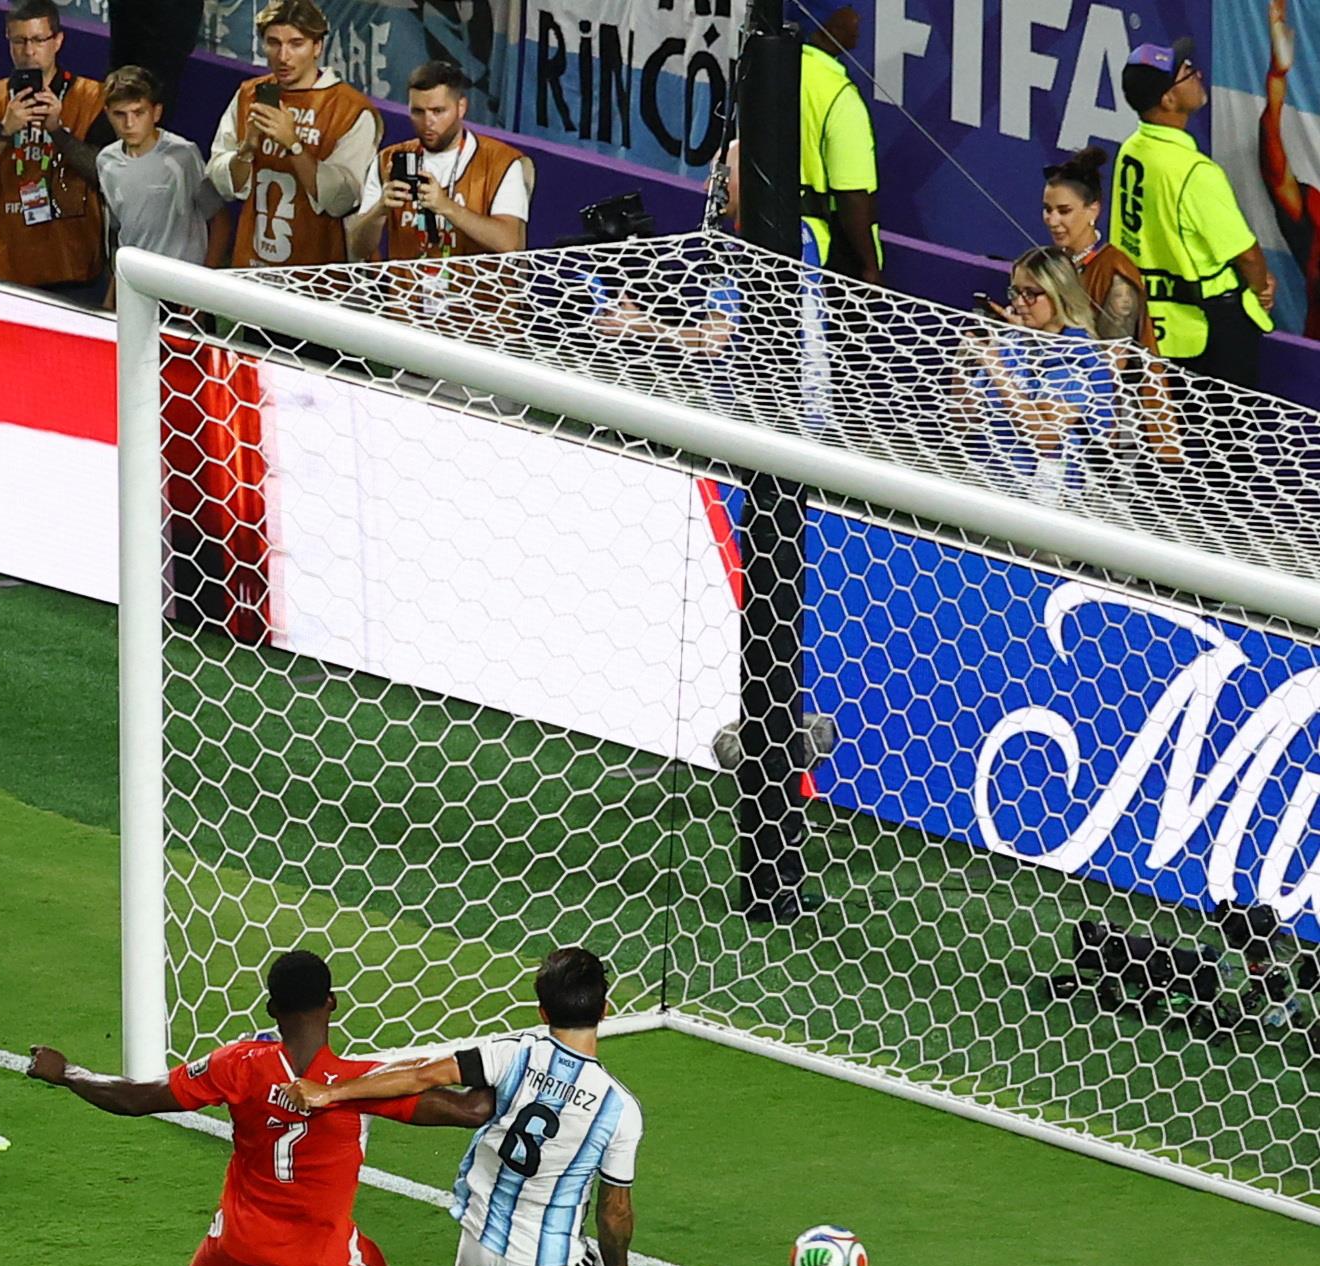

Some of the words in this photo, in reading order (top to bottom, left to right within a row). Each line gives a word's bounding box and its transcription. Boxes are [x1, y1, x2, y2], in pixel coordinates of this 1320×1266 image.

[873, 0, 1143, 153] FIFA
[526, 1066, 598, 1112] MARTINEZ
[266, 1116, 308, 1184] 7
[498, 1101, 560, 1178] 6
